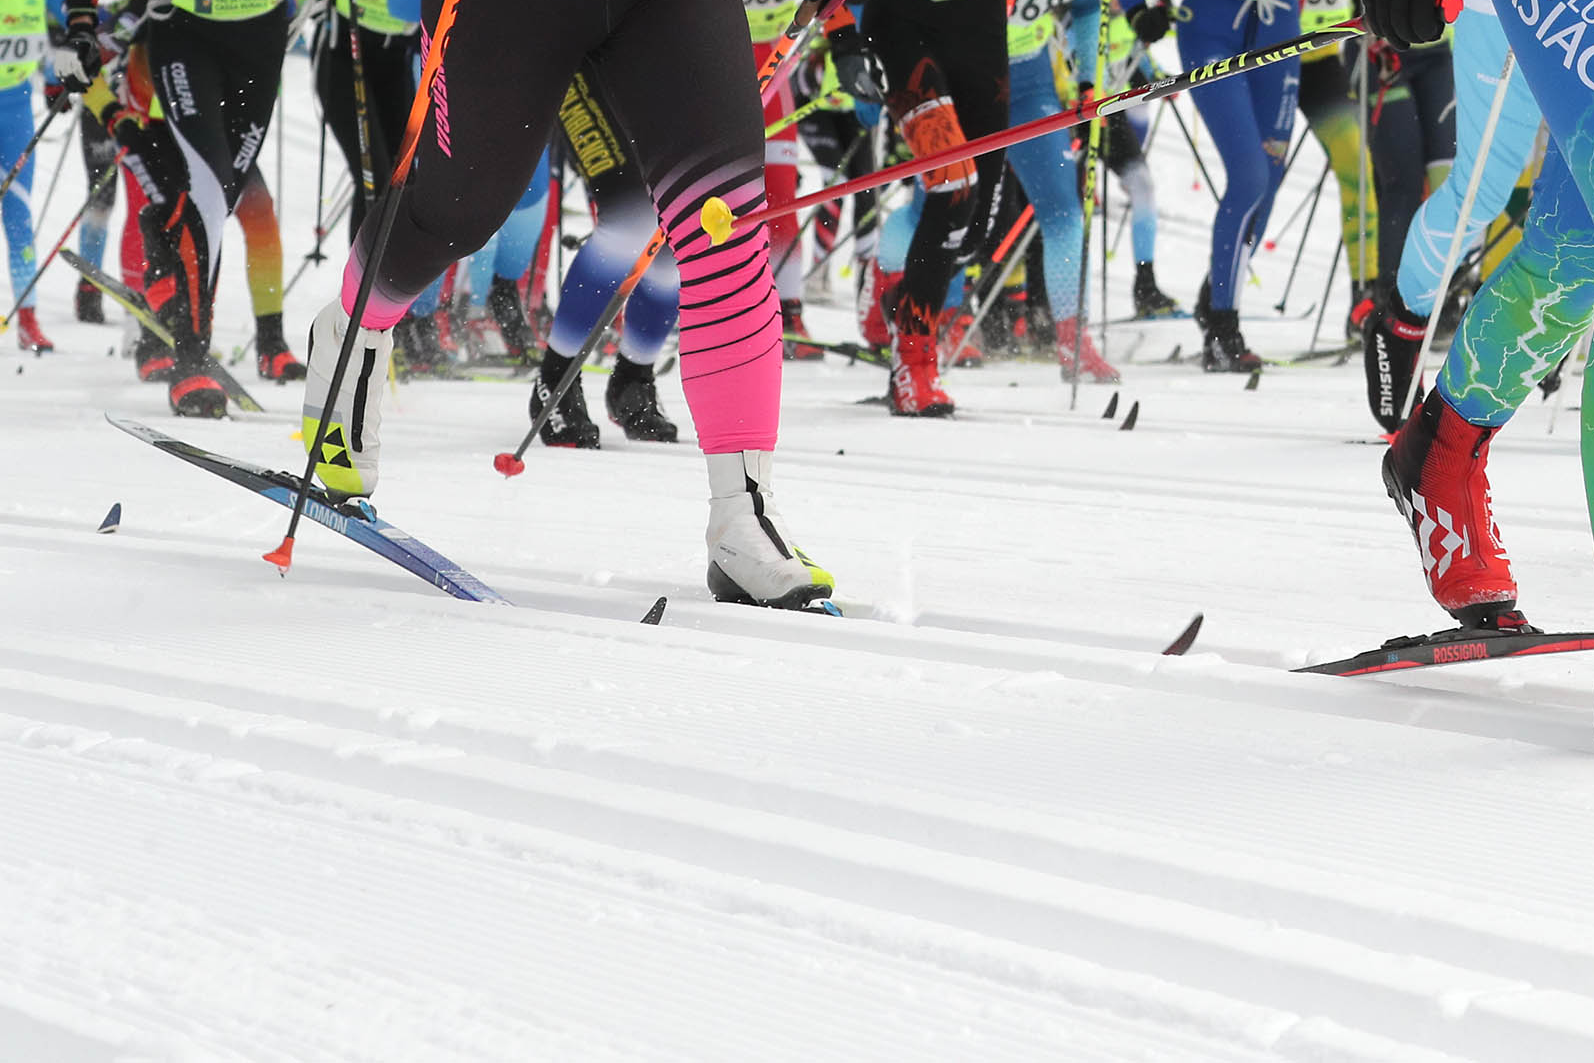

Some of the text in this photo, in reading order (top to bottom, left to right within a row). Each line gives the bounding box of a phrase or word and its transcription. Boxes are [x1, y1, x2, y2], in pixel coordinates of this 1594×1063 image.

[1189, 51, 1250, 84] LEKI
[1376, 333, 1394, 417] MADSHUS
[288, 491, 348, 534] SLOMON
[1432, 642, 1489, 664] ROSSIGNOL
